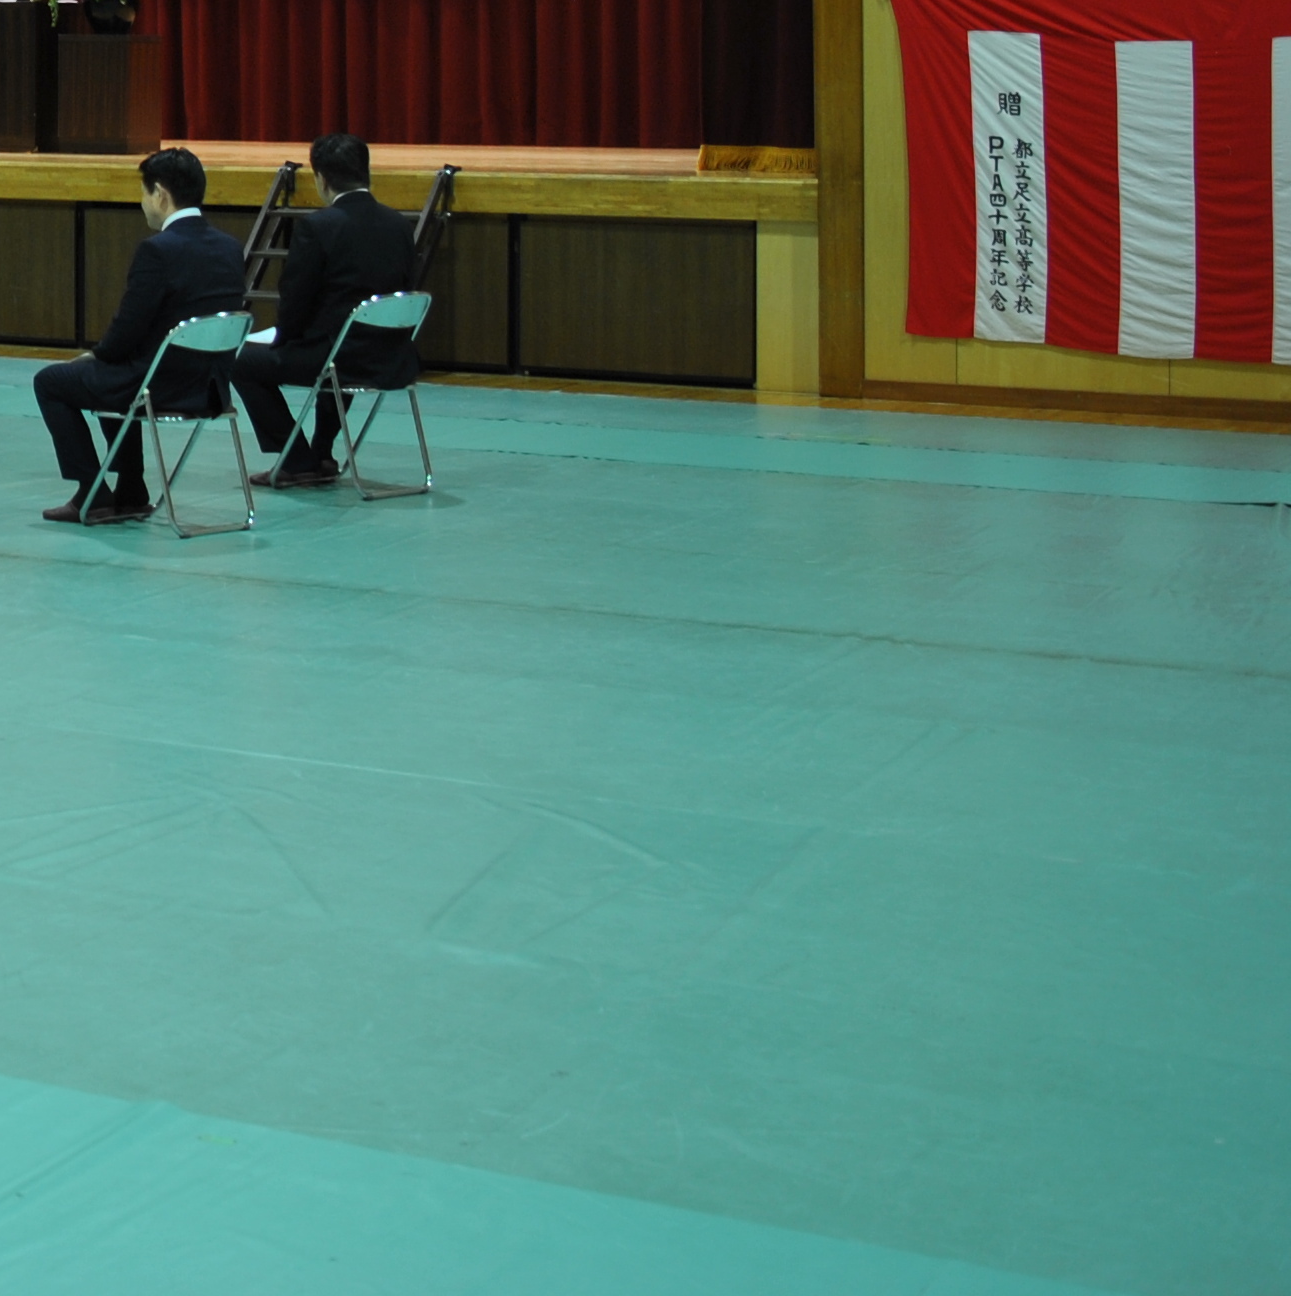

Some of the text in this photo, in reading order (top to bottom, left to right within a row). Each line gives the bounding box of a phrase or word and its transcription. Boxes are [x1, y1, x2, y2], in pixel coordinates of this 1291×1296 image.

[997, 92, 1021, 116] 贈
[988, 136, 1009, 312] PTA四十周年記念
[1012, 138, 1034, 314] 都立足立高等学校
